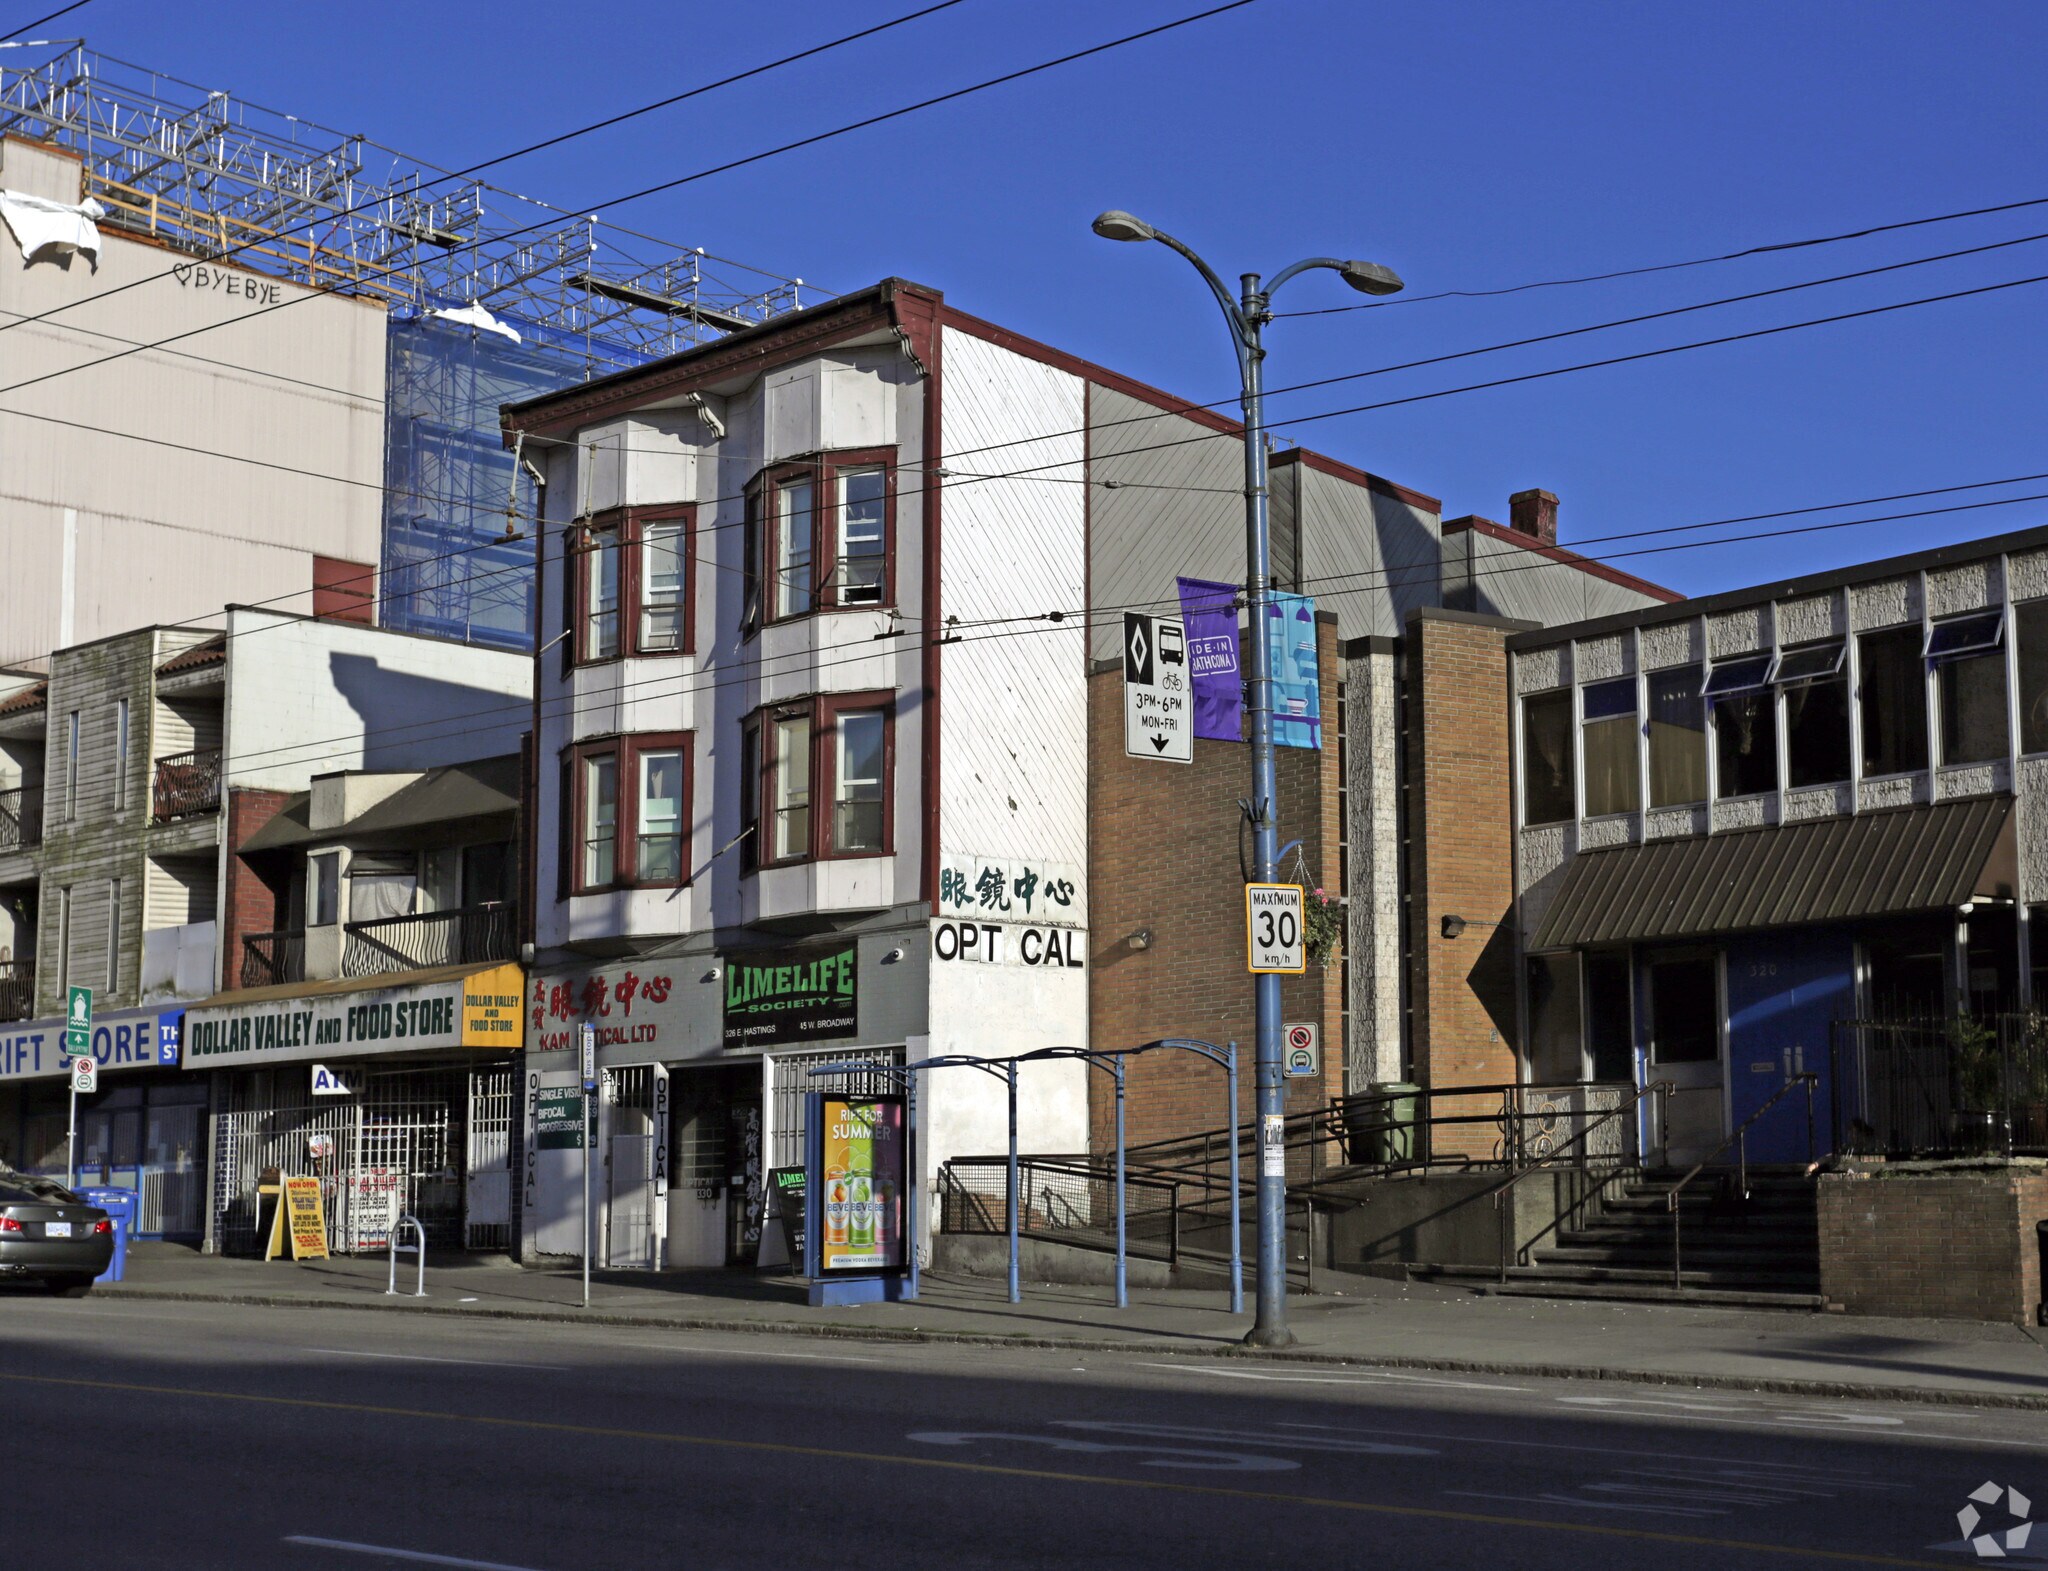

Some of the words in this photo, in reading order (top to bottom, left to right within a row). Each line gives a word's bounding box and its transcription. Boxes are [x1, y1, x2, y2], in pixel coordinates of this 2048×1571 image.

[1142, 715, 1178, 731] MON-FRI
[941, 866, 1075, 914] 眼鏡中心
[1253, 893, 1298, 906] MAXIMUM
[1257, 910, 1296, 948] 30
[1264, 953, 1290, 964] km/h
[728, 949, 854, 1008] LIMELIFE
[465, 995, 493, 1007] DOLLAR
[494, 995, 520, 1007] VALLEY
[550, 971, 672, 1022] 眼鏡中心
[485, 1008, 499, 1018] AND
[748, 997, 830, 1013] SOCIETY
[191, 1018, 250, 1056] DOLLAR
[254, 1011, 314, 1050] VALLEY
[316, 1018, 342, 1045] AND
[347, 1002, 392, 1042] FOOD
[395, 996, 453, 1038] STORE
[470, 1020, 488, 1032] FOOD
[490, 1020, 513, 1032] STORE
[744, 1024, 776, 1036] HASTINGS
[817, 1017, 855, 1028] BROADWAY
[539, 1031, 571, 1051] KAM
[631, 1024, 657, 1044] LTD
[0, 1034, 45, 1075] IFT
[59, 1022, 150, 1069] SORE
[585, 1036, 593, 1056] Stop
[314, 1069, 363, 1088] ATM
[539, 1088, 563, 1100] SINGLE
[538, 1106, 566, 1119] BIFOCAL
[840, 1109, 862, 1122] RIPE
[864, 1109, 883, 1122] FOR
[537, 1120, 584, 1133] PROGRESSIVE
[832, 1124, 891, 1141] SUMMER
[525, 1073, 538, 1207] OPTICAL
[655, 1077, 667, 1197] OPTICAL
[697, 1187, 712, 1199] 330
